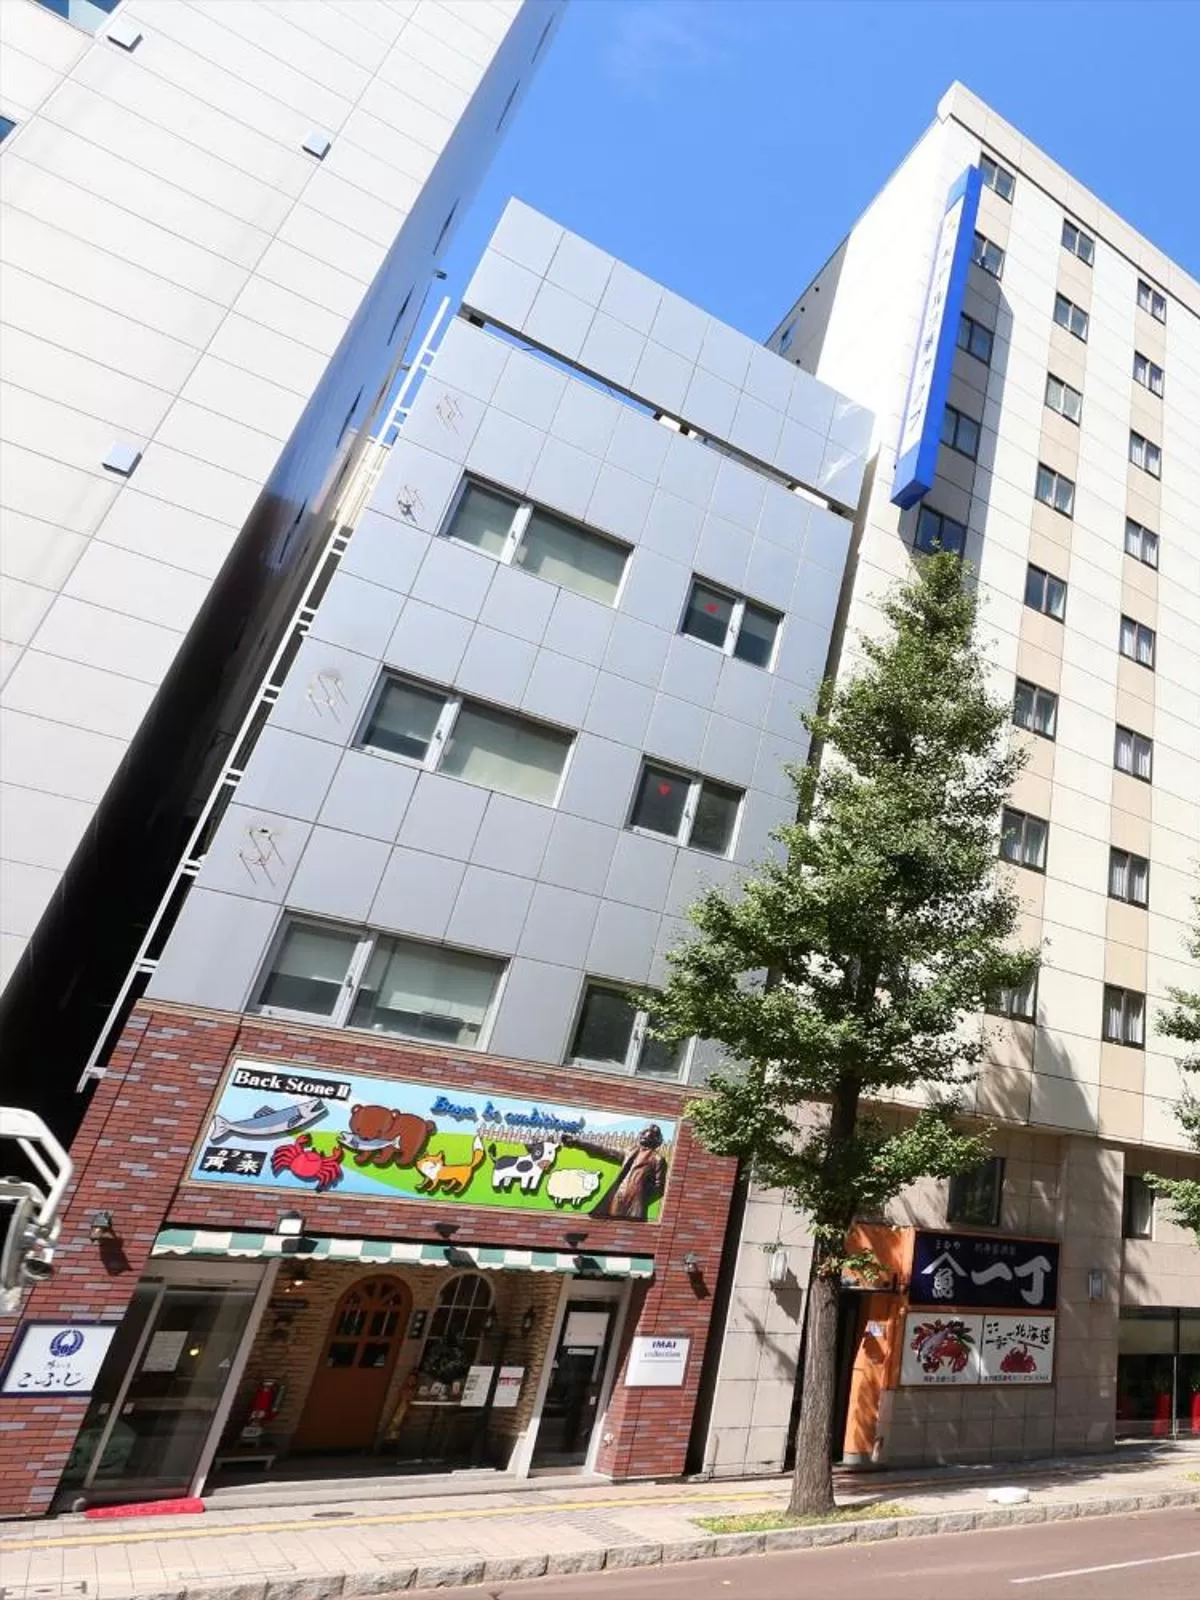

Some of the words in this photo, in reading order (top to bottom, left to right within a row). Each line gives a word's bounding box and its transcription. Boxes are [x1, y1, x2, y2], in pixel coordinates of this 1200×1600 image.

[235, 1070, 281, 1090] Back
[285, 1077, 334, 1097] Stone
[652, 1340, 676, 1348] IMAI
